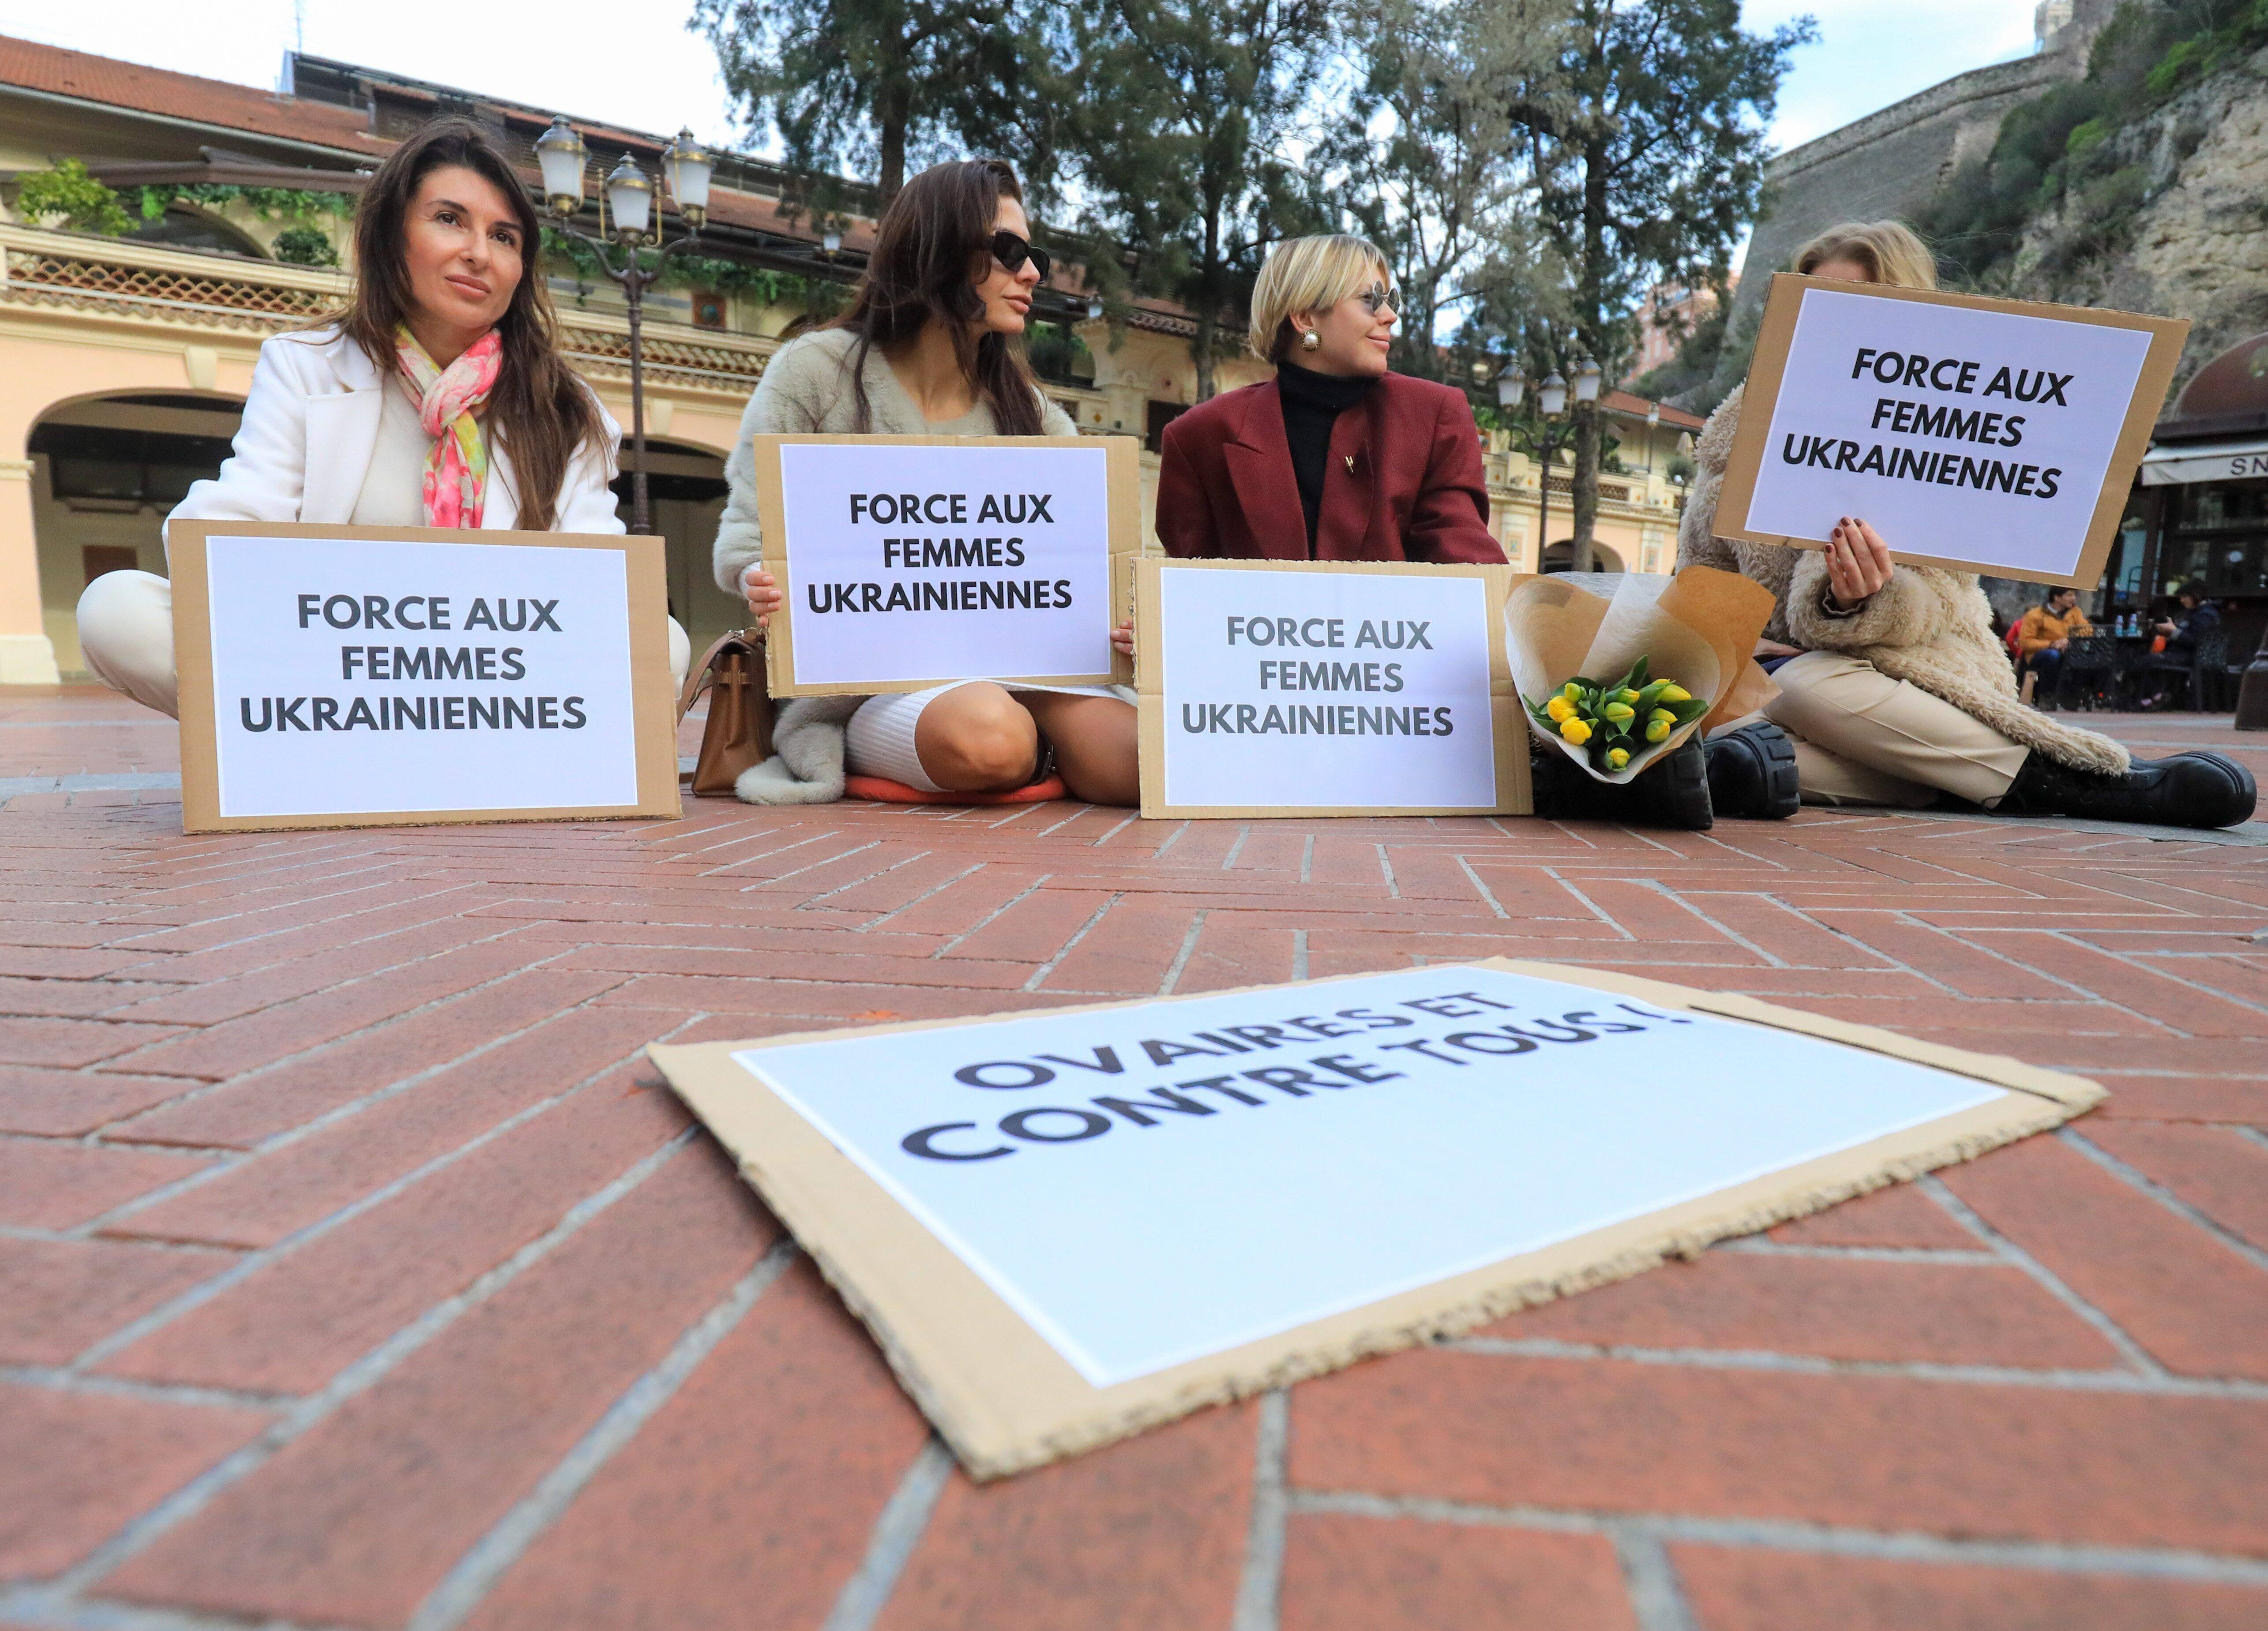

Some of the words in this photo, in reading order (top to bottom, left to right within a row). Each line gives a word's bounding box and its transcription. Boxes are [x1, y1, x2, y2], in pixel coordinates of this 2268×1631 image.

[1851, 348, 1981, 394] FORCE
[1981, 366, 2075, 407] AUX
[1870, 398, 2027, 447] FEMMES
[1783, 432, 2063, 499] UKRAINIENNES
[850, 493, 967, 525] FORCE
[976, 494, 1055, 524] AUX
[883, 537, 1025, 568] FEMMES
[297, 594, 451, 630] FORCE
[463, 598, 563, 632] AUX
[808, 579, 1072, 614] UKRAINIENNES
[1228, 616, 1344, 648] FORCE
[1354, 620, 1434, 650] AUX
[342, 646, 526, 681] FEMMES
[1260, 661, 1404, 693] FEMMES
[240, 696, 586, 732] UKRAINIENNES
[1183, 703, 1453, 737] UKRAINIENNES
[954, 1009, 1415, 1090] OVAIRES
[1400, 992, 1517, 1020] ET
[901, 1054, 1405, 1162] CONTRE
